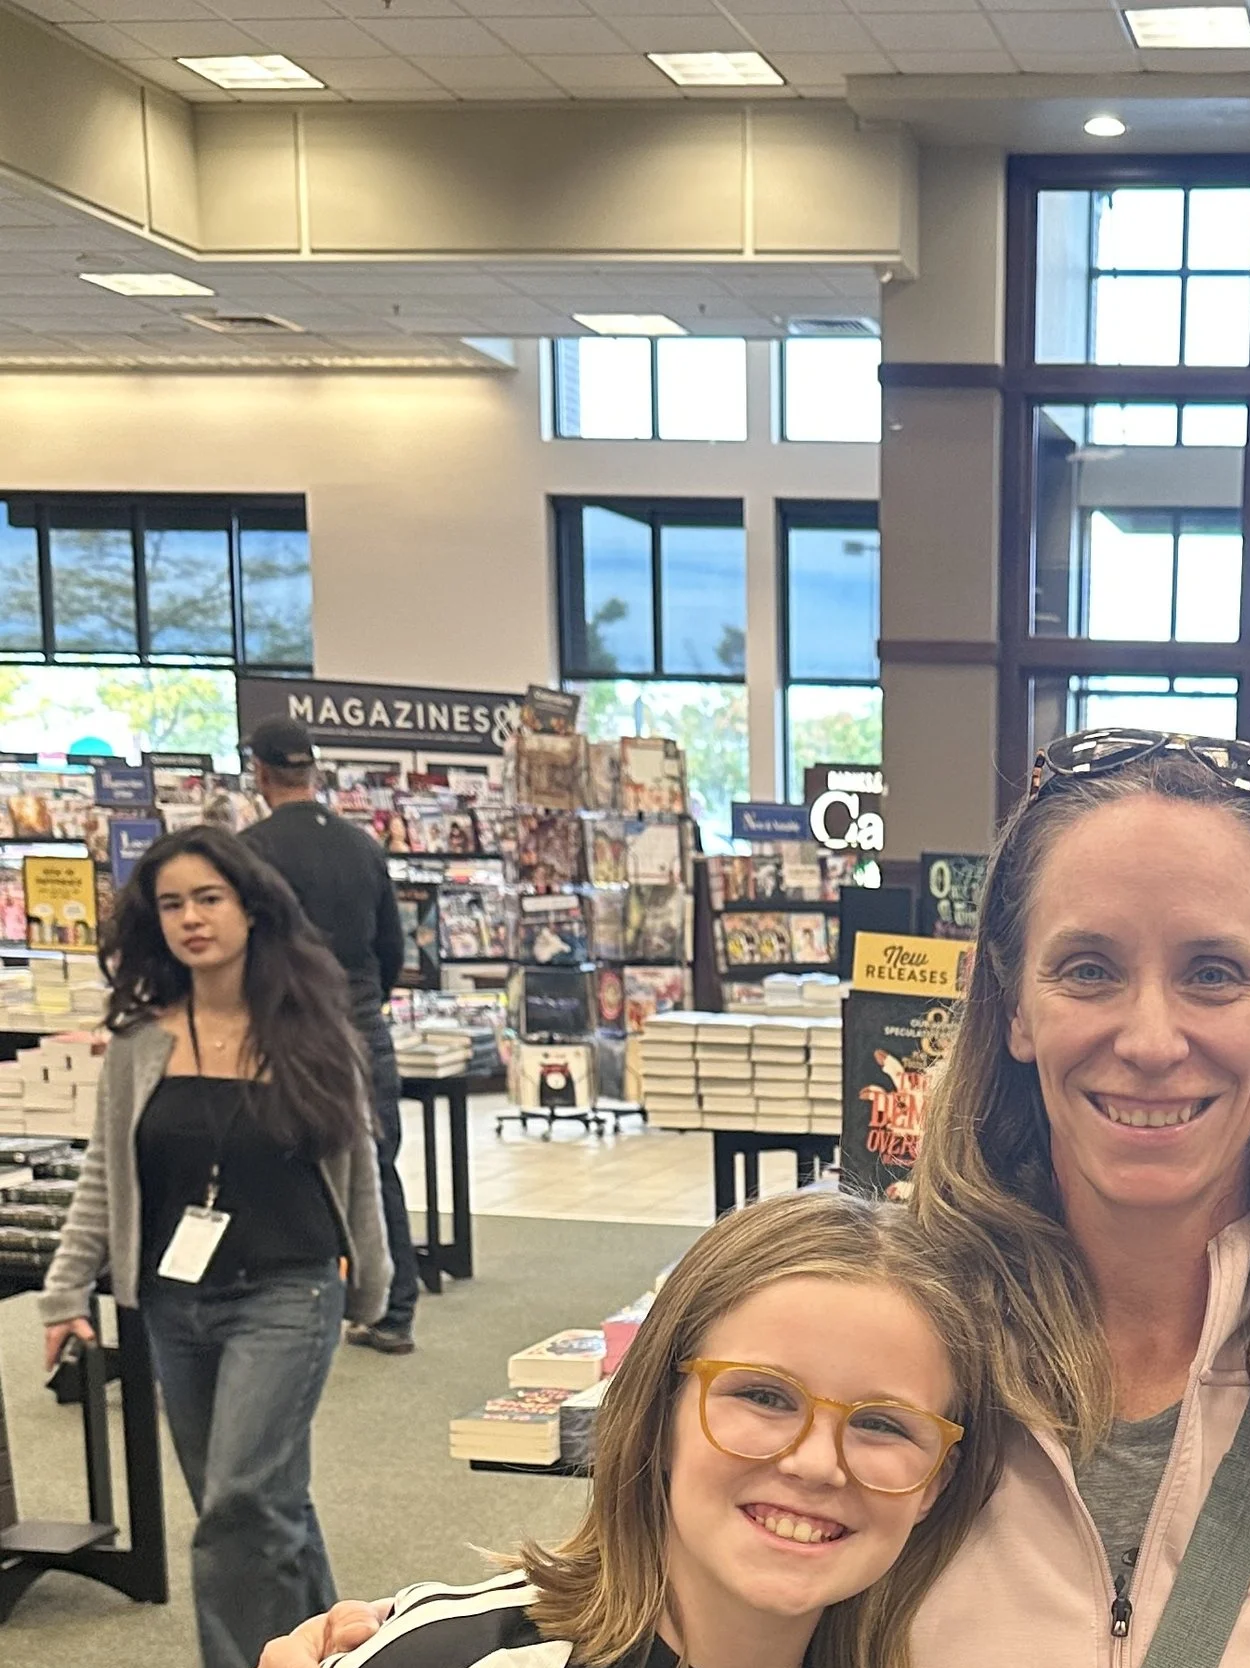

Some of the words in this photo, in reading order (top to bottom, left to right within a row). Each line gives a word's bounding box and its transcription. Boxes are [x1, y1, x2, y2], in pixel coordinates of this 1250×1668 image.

[287, 693, 490, 733] MAGAZINES
[884, 945, 929, 967] New
[865, 964, 948, 986] RELEASES
